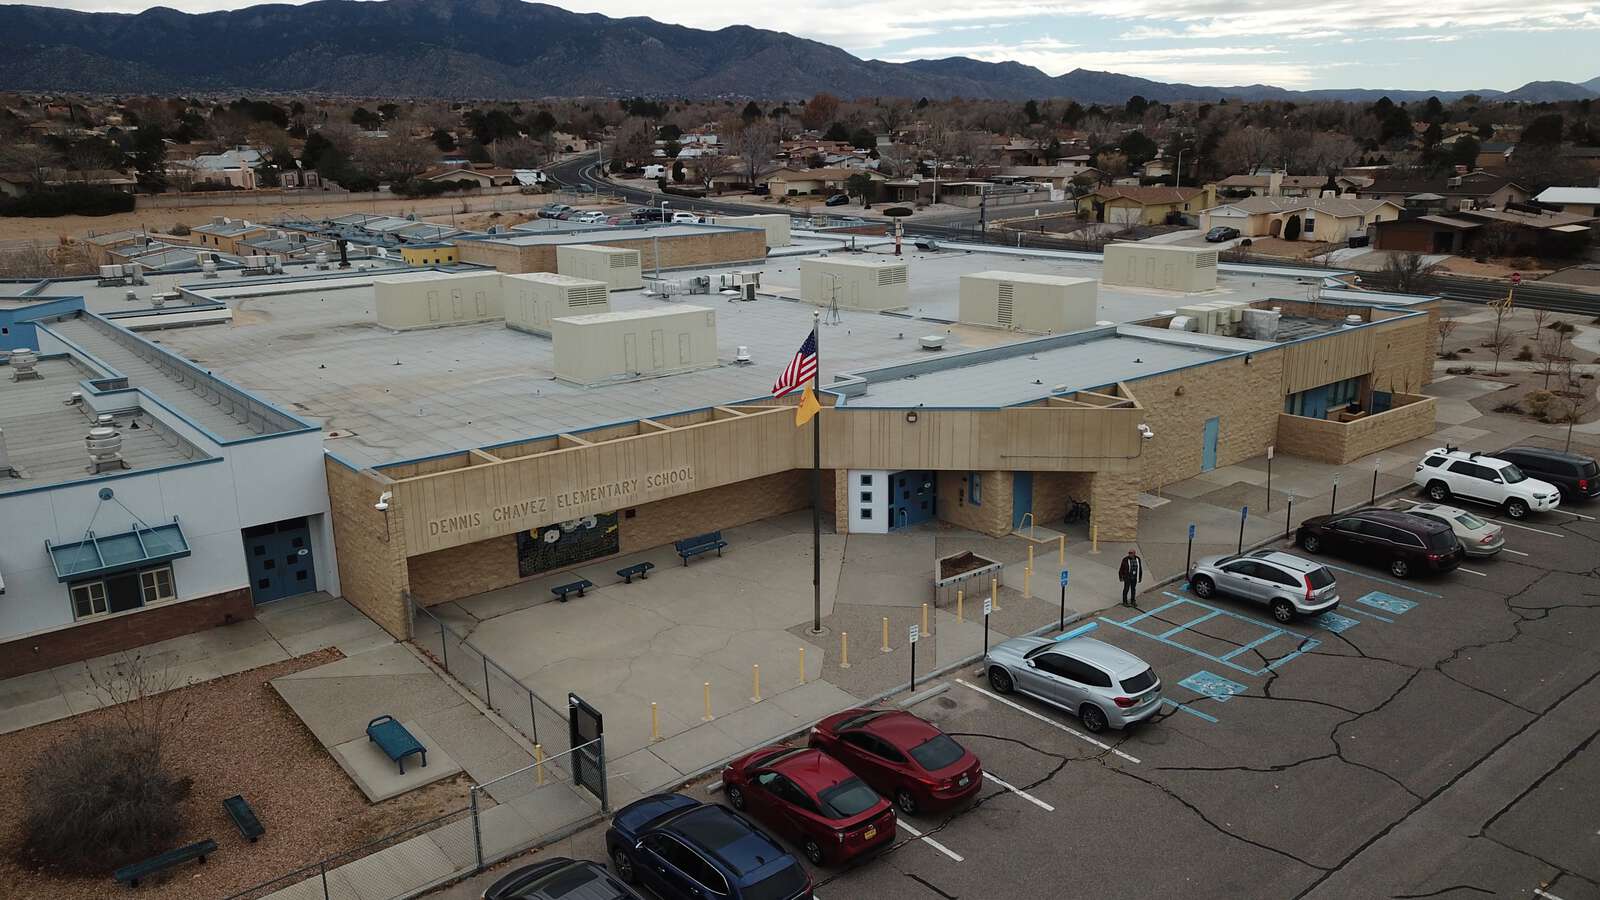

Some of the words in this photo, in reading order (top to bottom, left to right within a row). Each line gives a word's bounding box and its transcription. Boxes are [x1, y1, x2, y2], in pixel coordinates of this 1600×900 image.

[430, 513, 480, 536] DENNIS
[493, 499, 546, 521] CHAVEZ
[557, 479, 637, 508] ELEMENTARY
[647, 467, 693, 488] SCHOOL
